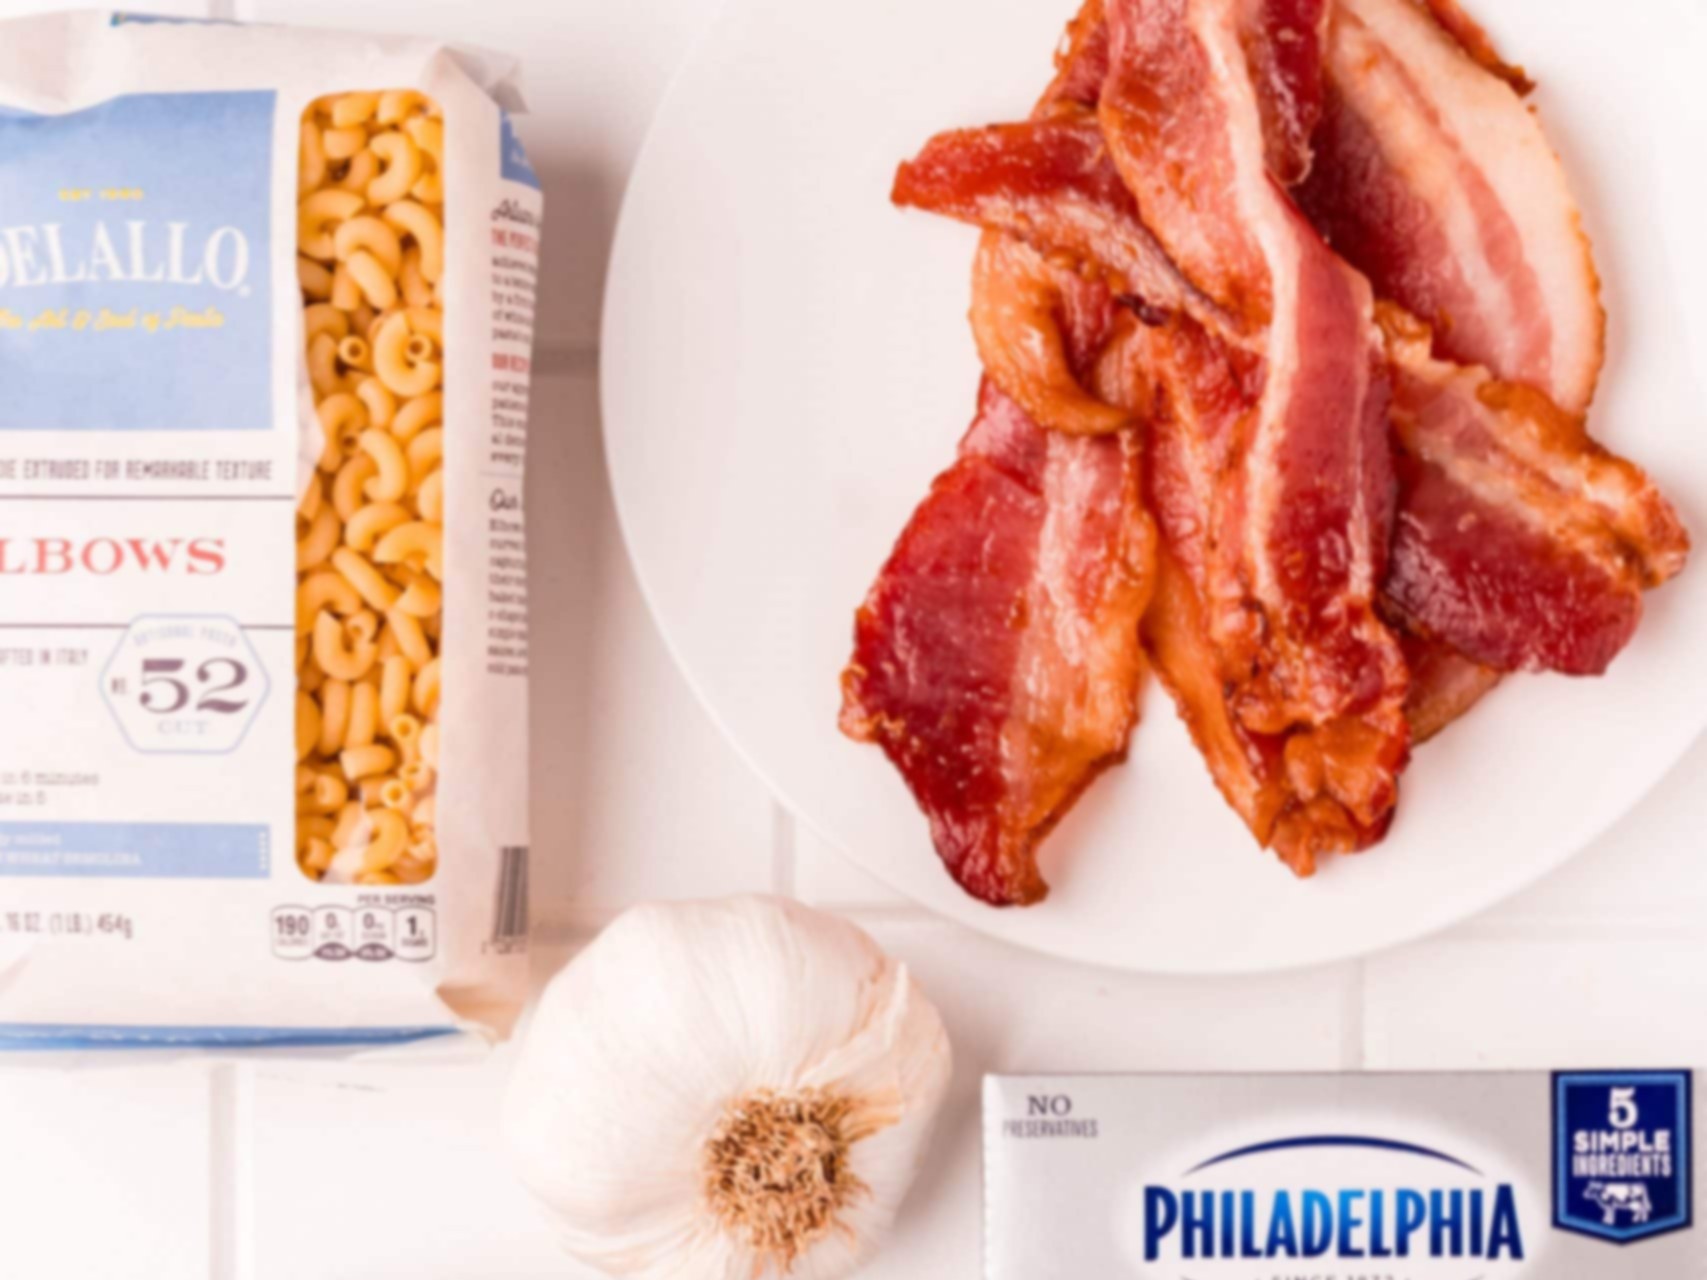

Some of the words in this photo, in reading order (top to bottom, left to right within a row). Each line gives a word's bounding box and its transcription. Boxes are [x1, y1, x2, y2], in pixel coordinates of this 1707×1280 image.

[96, 460, 120, 480] FOR
[139, 656, 249, 714] 52
[275, 914, 309, 936] 190
[1026, 1094, 1073, 1117] NO
[1608, 1087, 1637, 1129] 5
[1002, 1118, 1099, 1139] PRESERVATIVES
[1572, 1130, 1671, 1153] SIMPLE
[1572, 1154, 1672, 1178] INGREDIENTS
[1143, 1182, 1525, 1263] PHILADELPHIA
